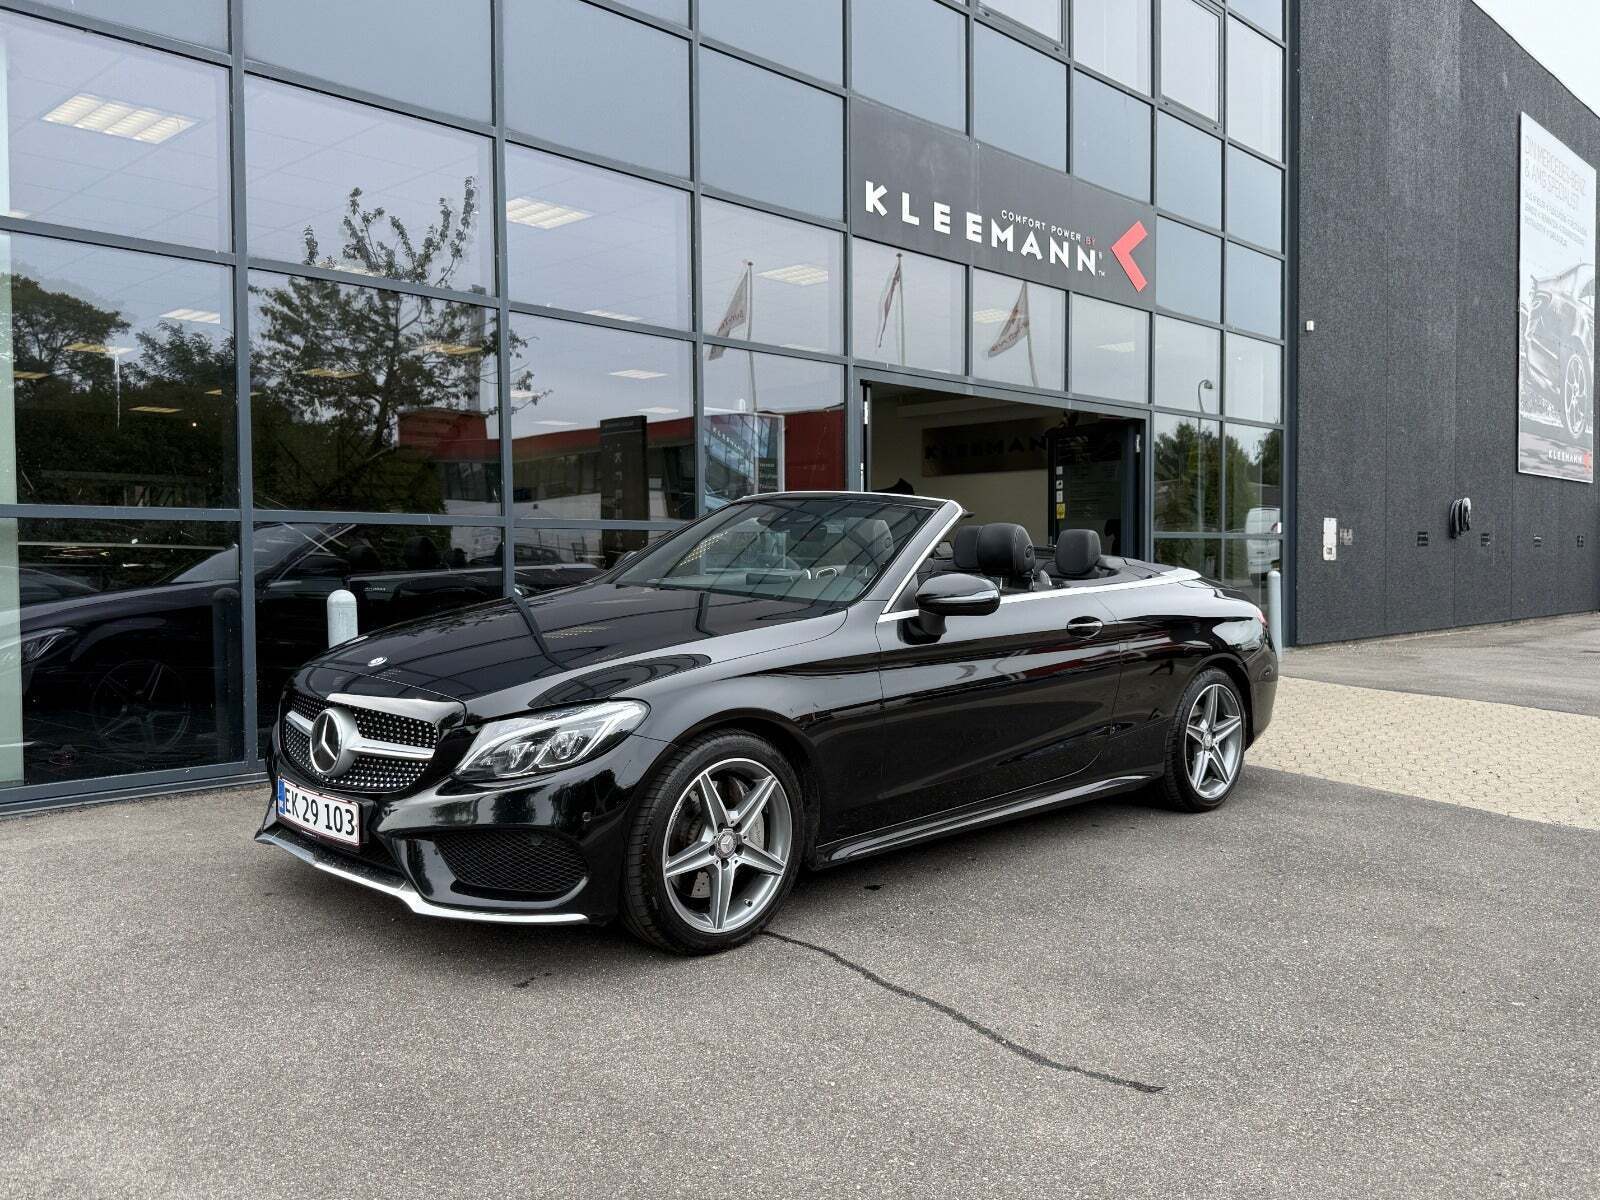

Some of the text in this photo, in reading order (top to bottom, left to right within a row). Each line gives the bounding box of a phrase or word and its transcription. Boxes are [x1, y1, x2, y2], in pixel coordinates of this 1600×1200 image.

[865, 180, 1096, 276] KLEEMANN
[1001, 209, 1096, 246] COMFORT POWER BY
[1548, 449, 1583, 464] KLEEMANN
[285, 787, 355, 836] EK 29 103
